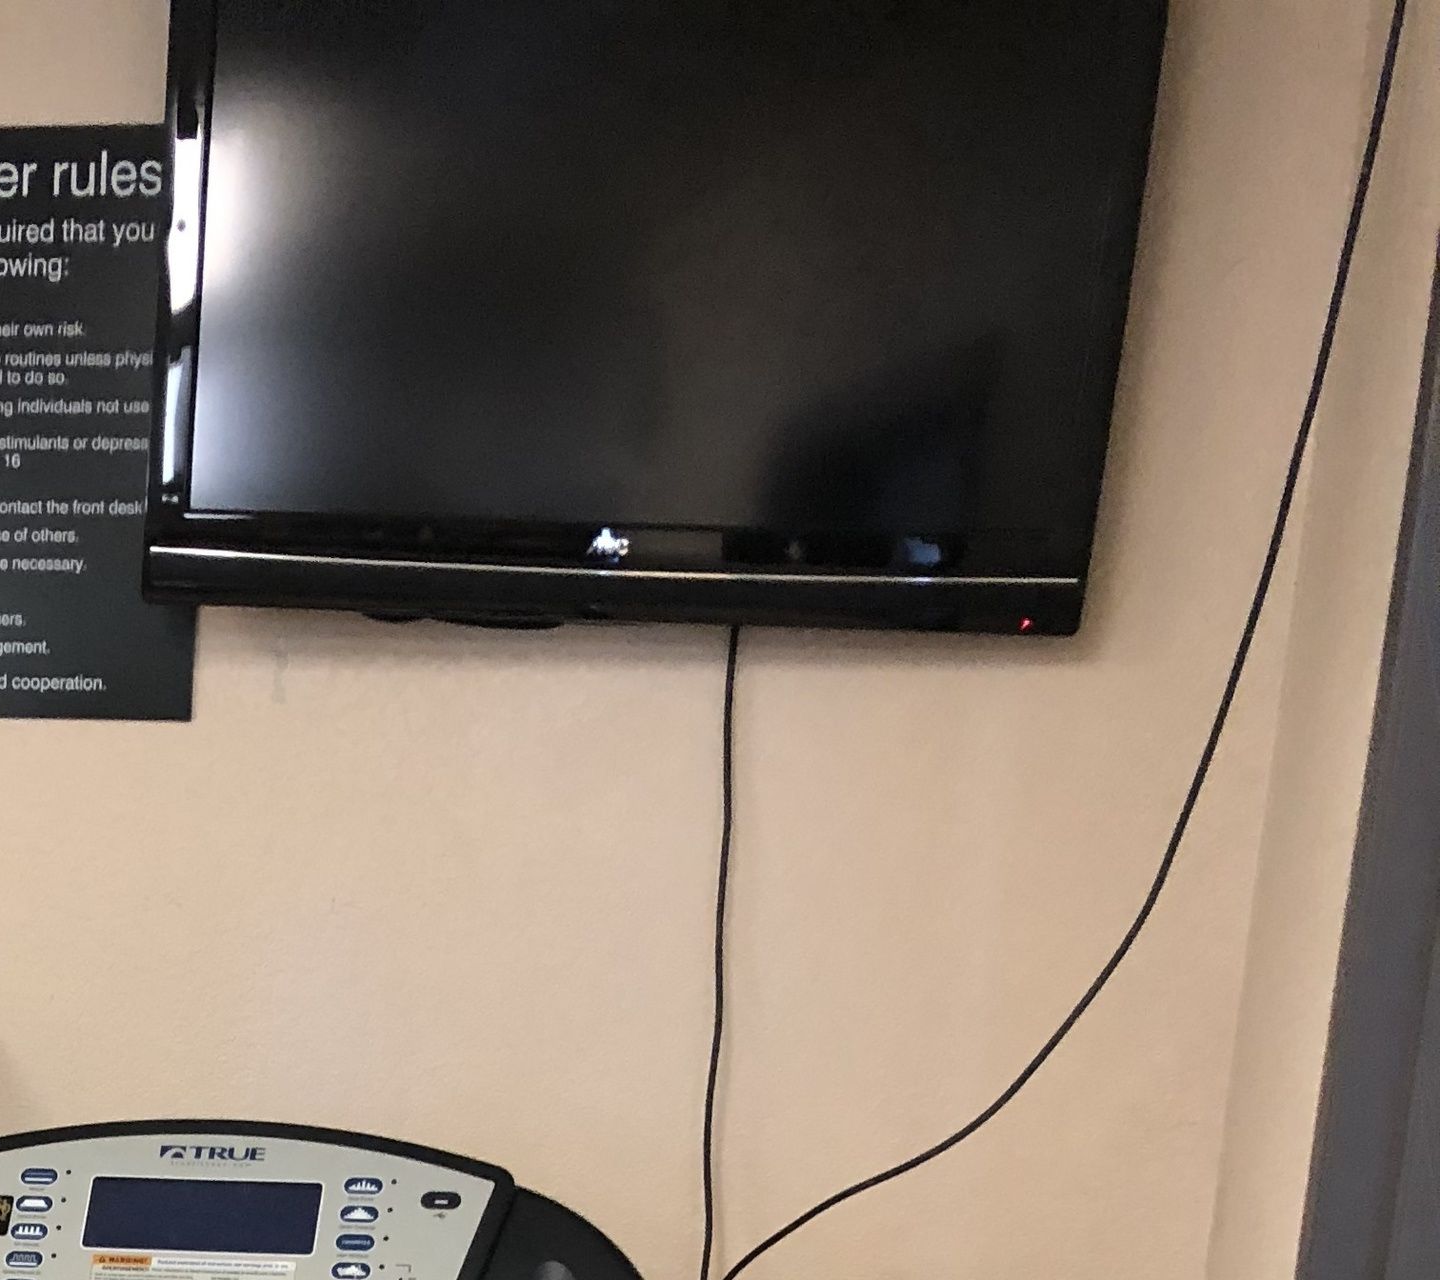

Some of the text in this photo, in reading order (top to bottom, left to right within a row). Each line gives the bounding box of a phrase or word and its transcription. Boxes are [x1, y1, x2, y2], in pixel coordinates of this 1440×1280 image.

[52, 149, 162, 197] rules
[61, 217, 105, 242] that
[111, 222, 154, 247] you
[23, 324, 53, 337] own
[4, 352, 61, 366] routines
[64, 352, 111, 366] unless
[6, 371, 21, 385] to
[24, 371, 44, 385] do
[17, 398, 92, 415] individuals
[96, 398, 119, 415] not
[123, 400, 150, 415] use
[72, 438, 88, 451] or
[45, 499, 69, 514] the
[72, 499, 105, 515] front
[13, 527, 28, 542] of
[189, 1146, 266, 1161] TRUE
